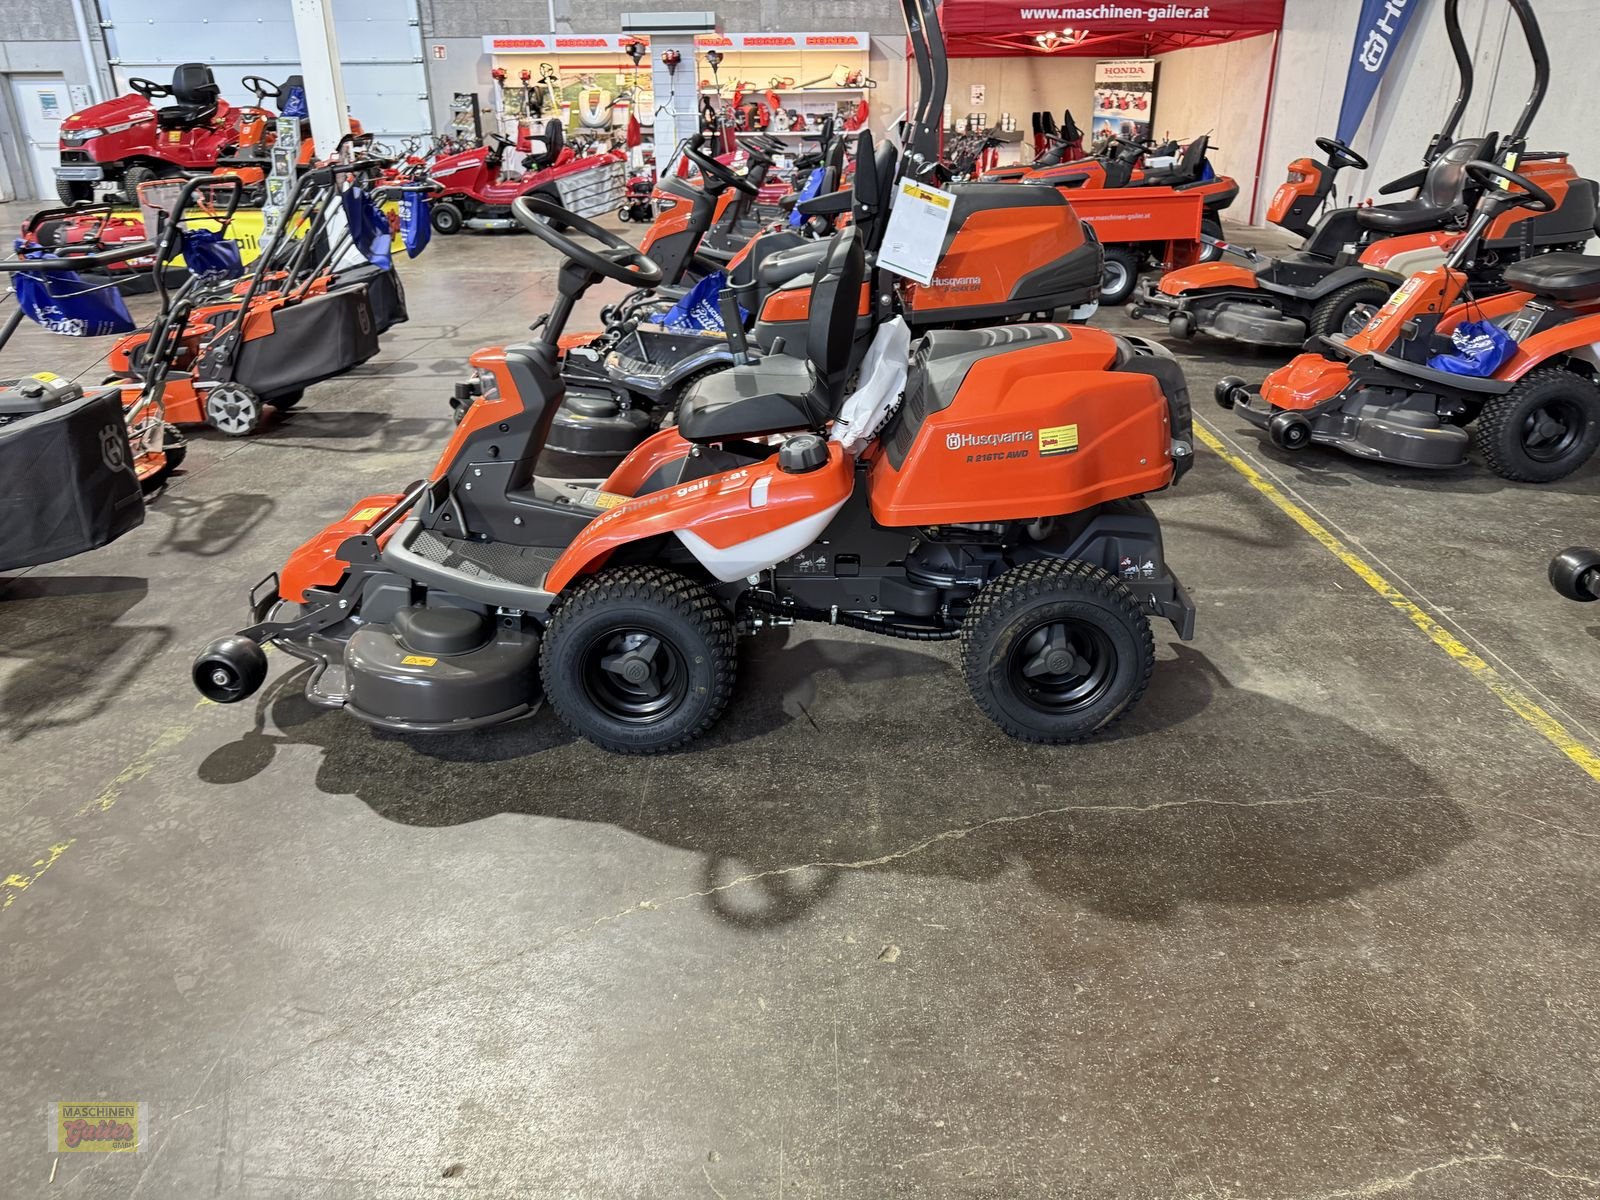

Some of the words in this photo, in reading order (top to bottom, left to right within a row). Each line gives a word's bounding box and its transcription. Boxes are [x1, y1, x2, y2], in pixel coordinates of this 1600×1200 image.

[1020, 4, 1209, 21] www.maschinen-gailer.at
[493, 39, 545, 48] HONDA
[556, 38, 608, 47] HONDA
[743, 37, 795, 46] HONDA
[806, 36, 858, 45] HONDA
[1104, 66, 1145, 75] HONDA
[931, 276, 982, 287] Husqvarna
[961, 430, 1034, 447] Husqvarna
[975, 452, 1005, 462] 216TC
[1006, 450, 1029, 459] AWD
